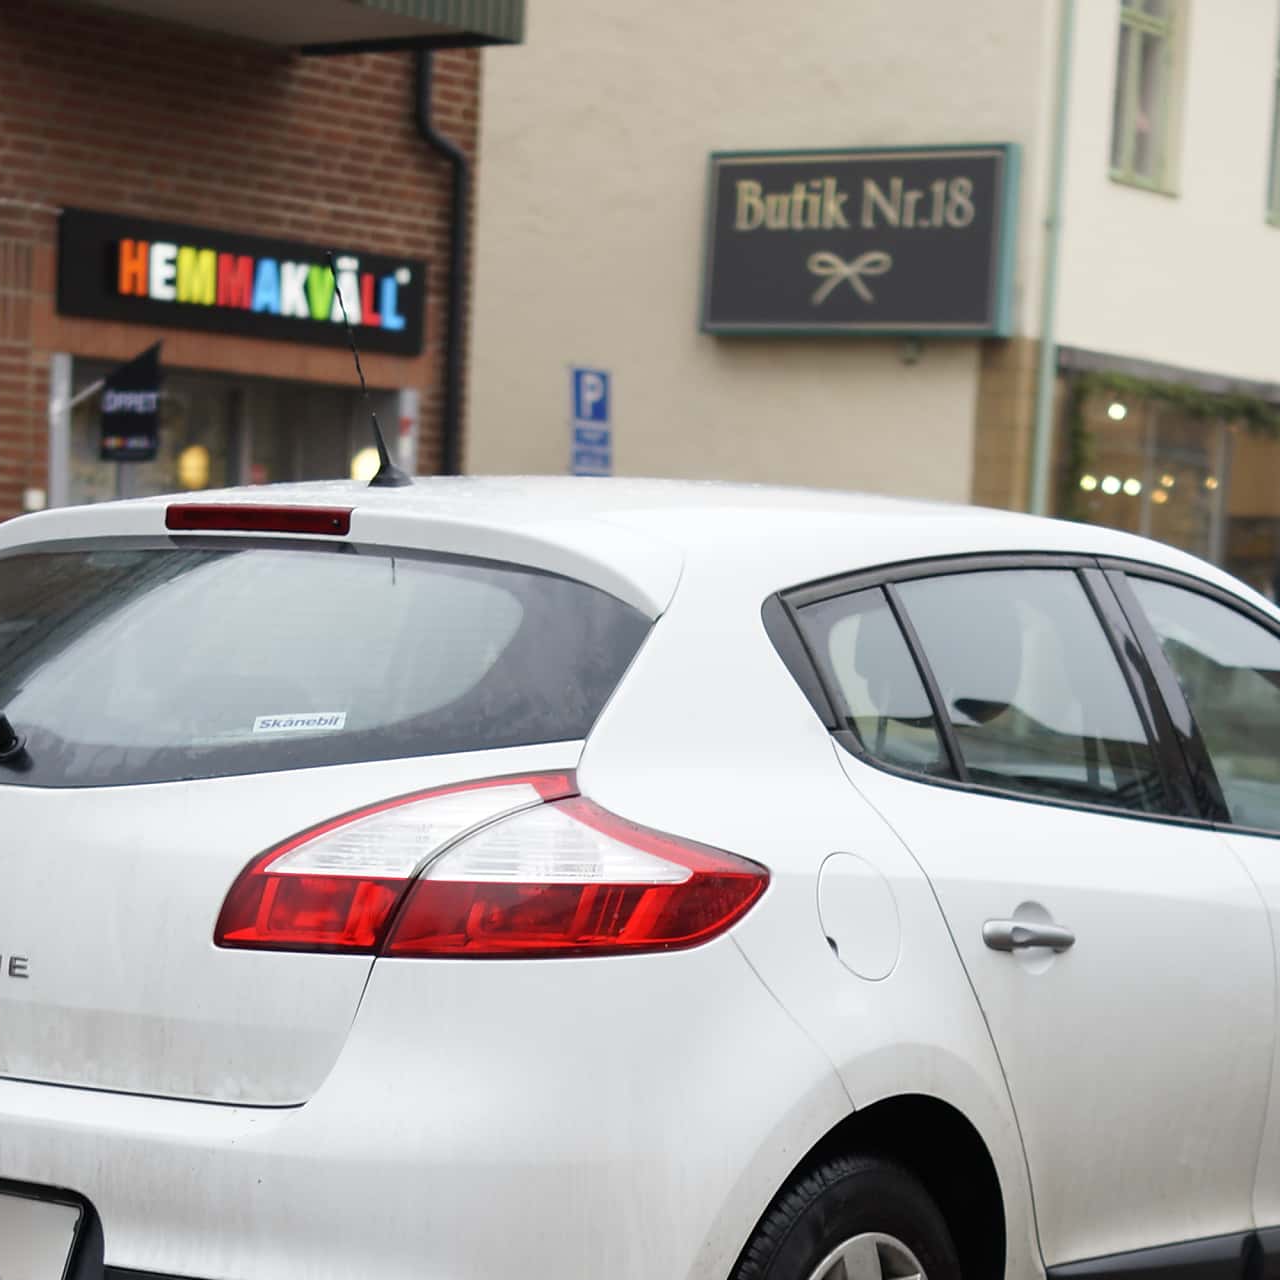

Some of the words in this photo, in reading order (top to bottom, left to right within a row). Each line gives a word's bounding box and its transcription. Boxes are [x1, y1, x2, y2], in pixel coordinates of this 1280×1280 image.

[734, 177, 850, 230] Butik
[861, 177, 975, 228] Nr.18
[118, 238, 406, 331] HEMMAKVÄLL
[581, 375, 603, 417] P
